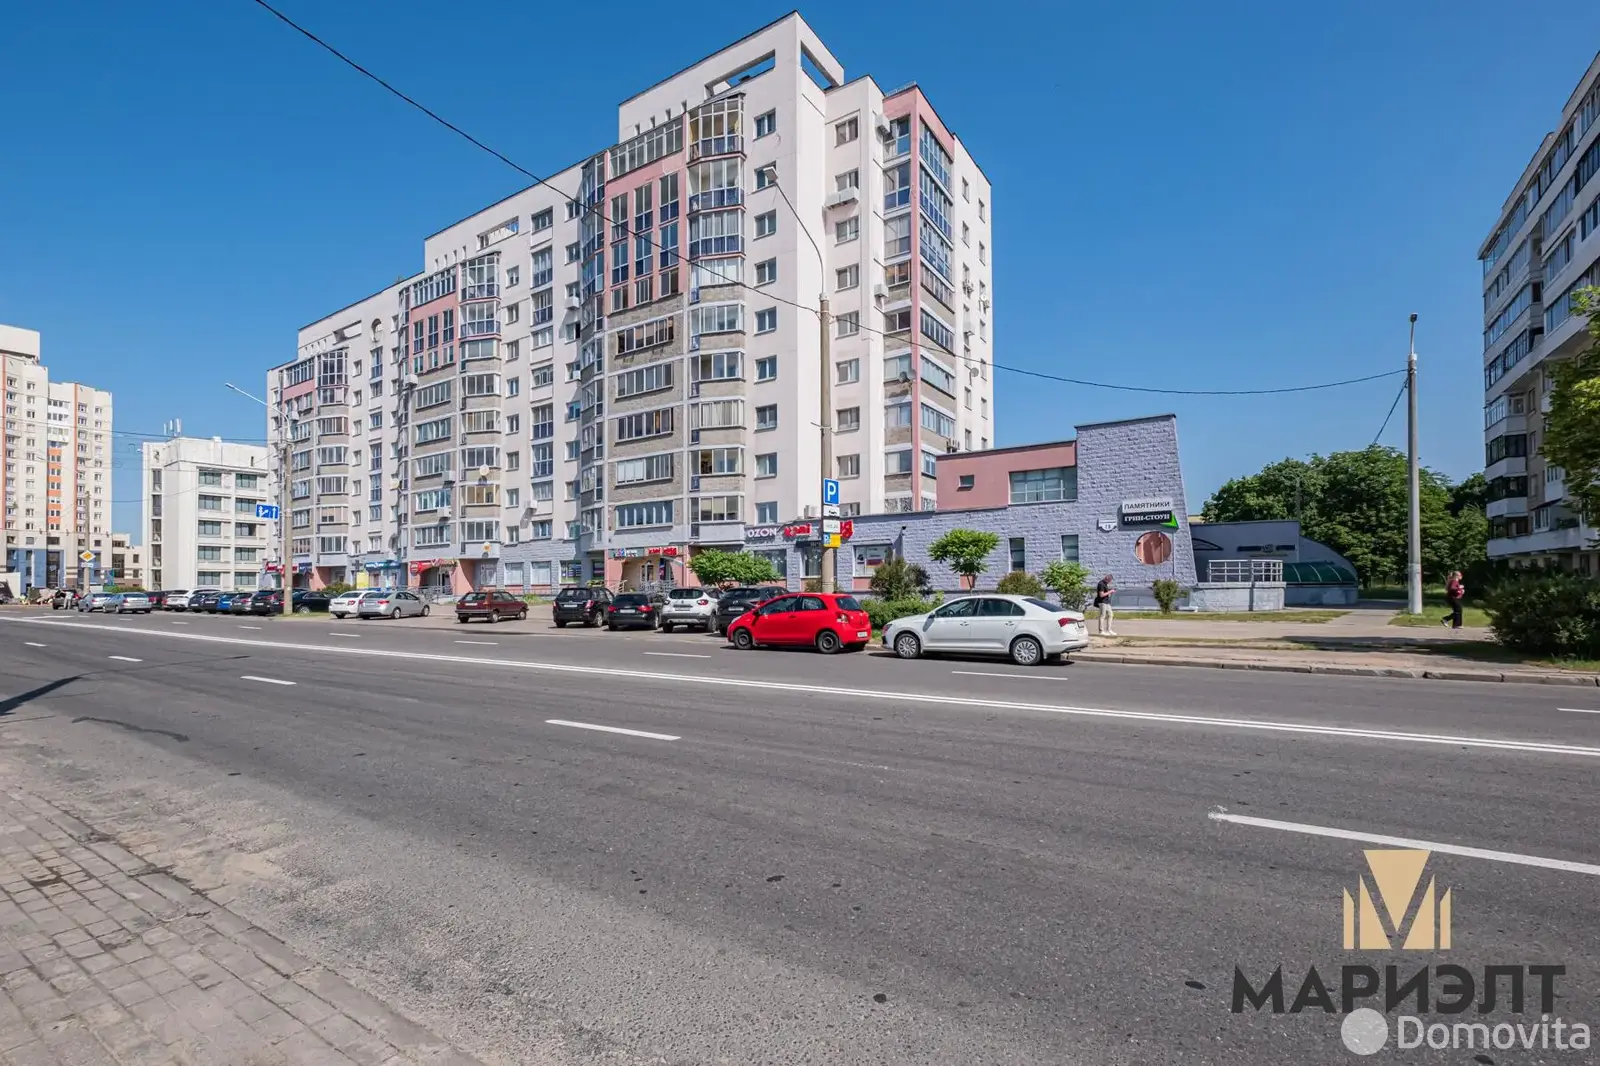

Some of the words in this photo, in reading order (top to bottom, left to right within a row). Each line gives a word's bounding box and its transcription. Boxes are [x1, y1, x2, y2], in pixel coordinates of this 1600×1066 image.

[827, 482, 837, 502] P
[1124, 501, 1170, 510] ПАМЯТНИКИ
[747, 528, 777, 538] OZON
